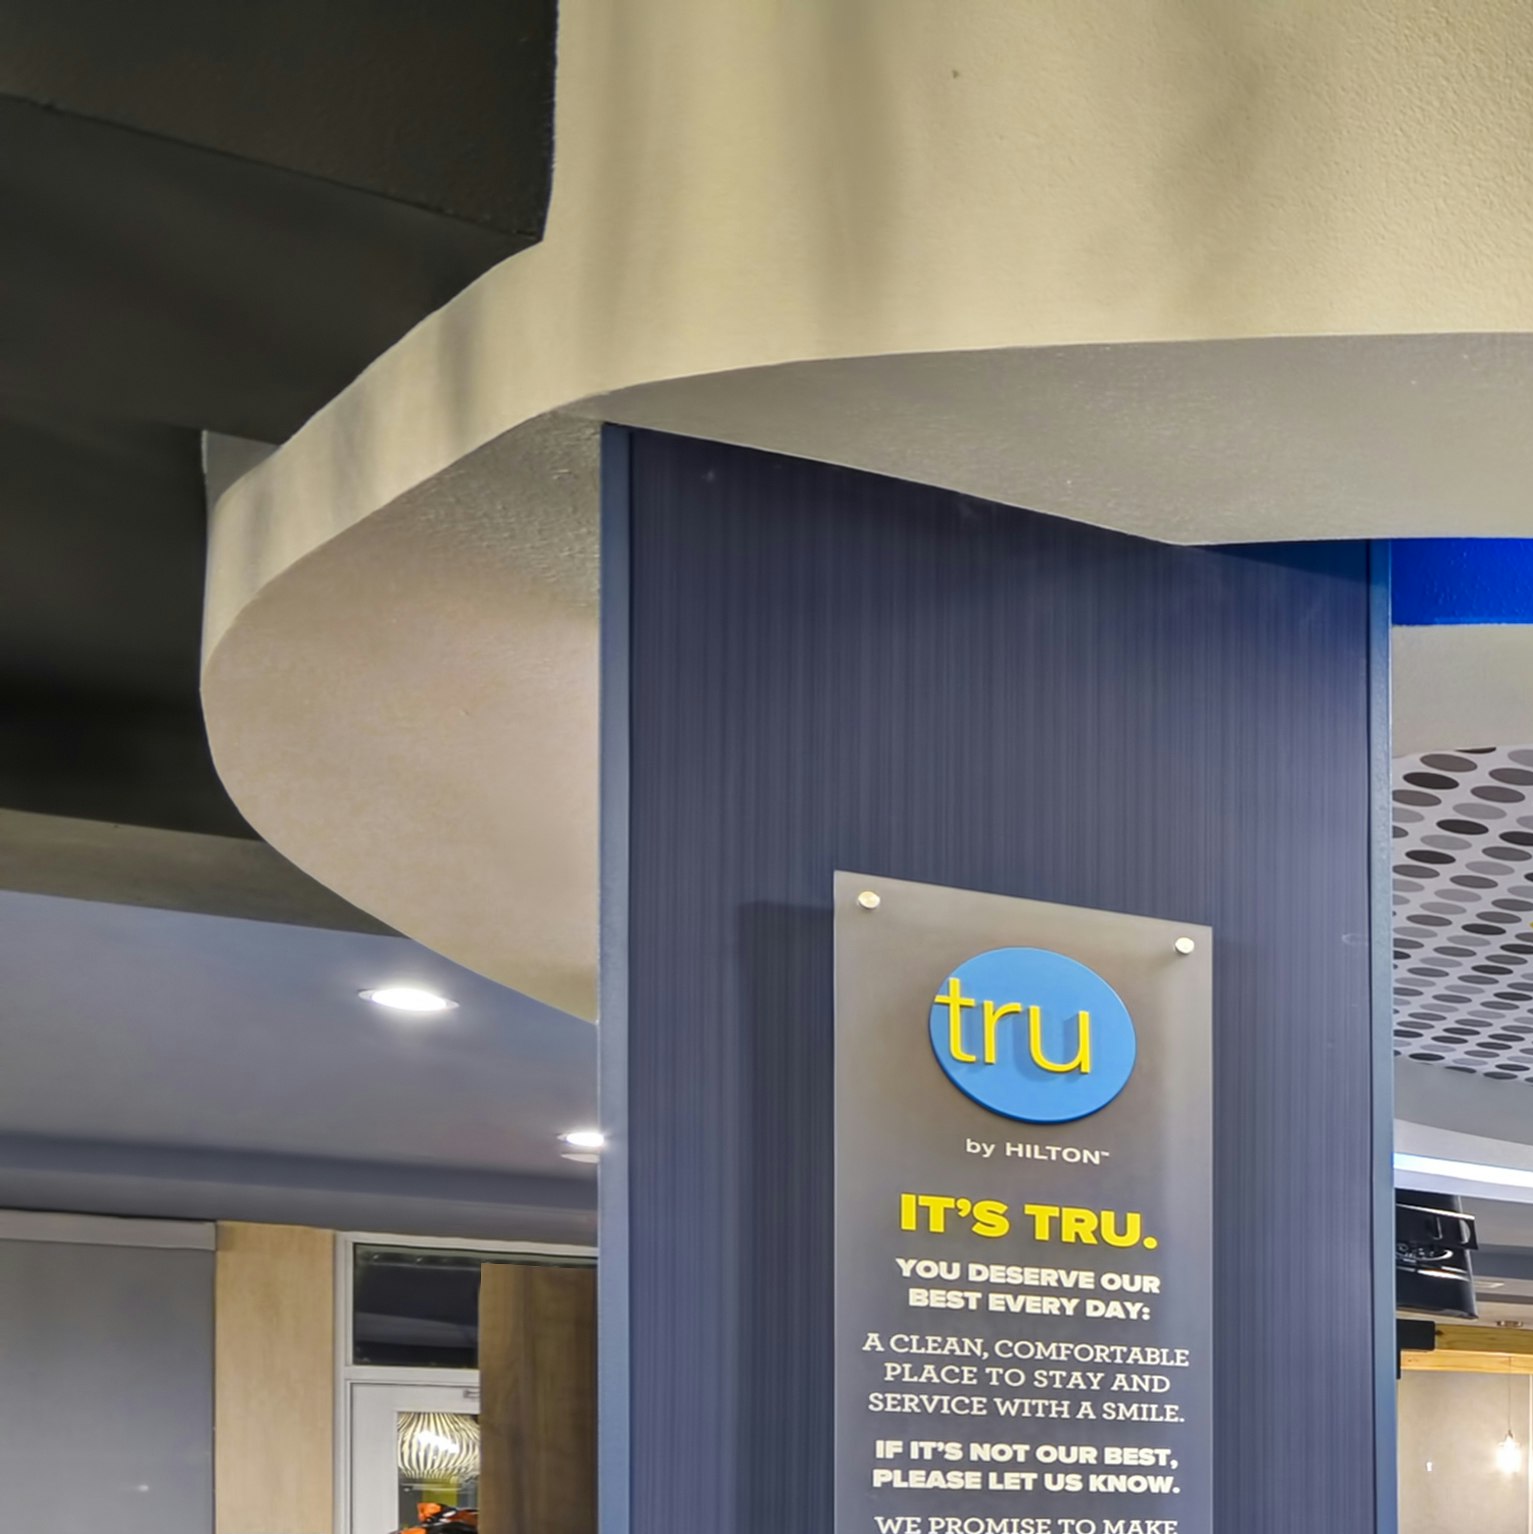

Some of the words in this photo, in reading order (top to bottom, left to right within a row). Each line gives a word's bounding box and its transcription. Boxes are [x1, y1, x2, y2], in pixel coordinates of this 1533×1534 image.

[935, 978, 1091, 1073] tru
[966, 1139, 995, 1158] by
[901, 1194, 1009, 1238] IT’S
[1024, 1203, 1158, 1250] TRU.
[896, 1259, 960, 1281] YOU
[969, 1264, 1095, 1289] DESERVE
[1101, 1272, 1160, 1293] OUR
[909, 1289, 981, 1310] BEST
[989, 1293, 1080, 1317] EVERY
[1086, 1300, 1151, 1320] DAY:
[863, 1333, 884, 1351] A
[890, 1335, 989, 1360] CLEAN,
[994, 1340, 1190, 1367] COMFORTABLE
[884, 1363, 977, 1385] PLACE
[986, 1368, 1025, 1387] TO
[1034, 1370, 1104, 1391] STAY
[1111, 1374, 1170, 1393] AND
[868, 1393, 987, 1416] SERVICE
[994, 1398, 1070, 1419] WITH
[1076, 1401, 1096, 1419] A
[1102, 1404, 1185, 1423] SMILE.
[876, 1441, 903, 1459] IF
[910, 1442, 962, 1460] IT’S
[970, 1445, 1030, 1462] NOT
[1036, 1446, 1097, 1464] OUR
[1104, 1447, 1178, 1469] BEST,
[873, 1469, 981, 1490] PLEASE
[989, 1473, 1037, 1491] LET
[1044, 1474, 1082, 1491] US
[1089, 1475, 1180, 1494] KNOW.
[875, 1516, 921, 1534] WE
